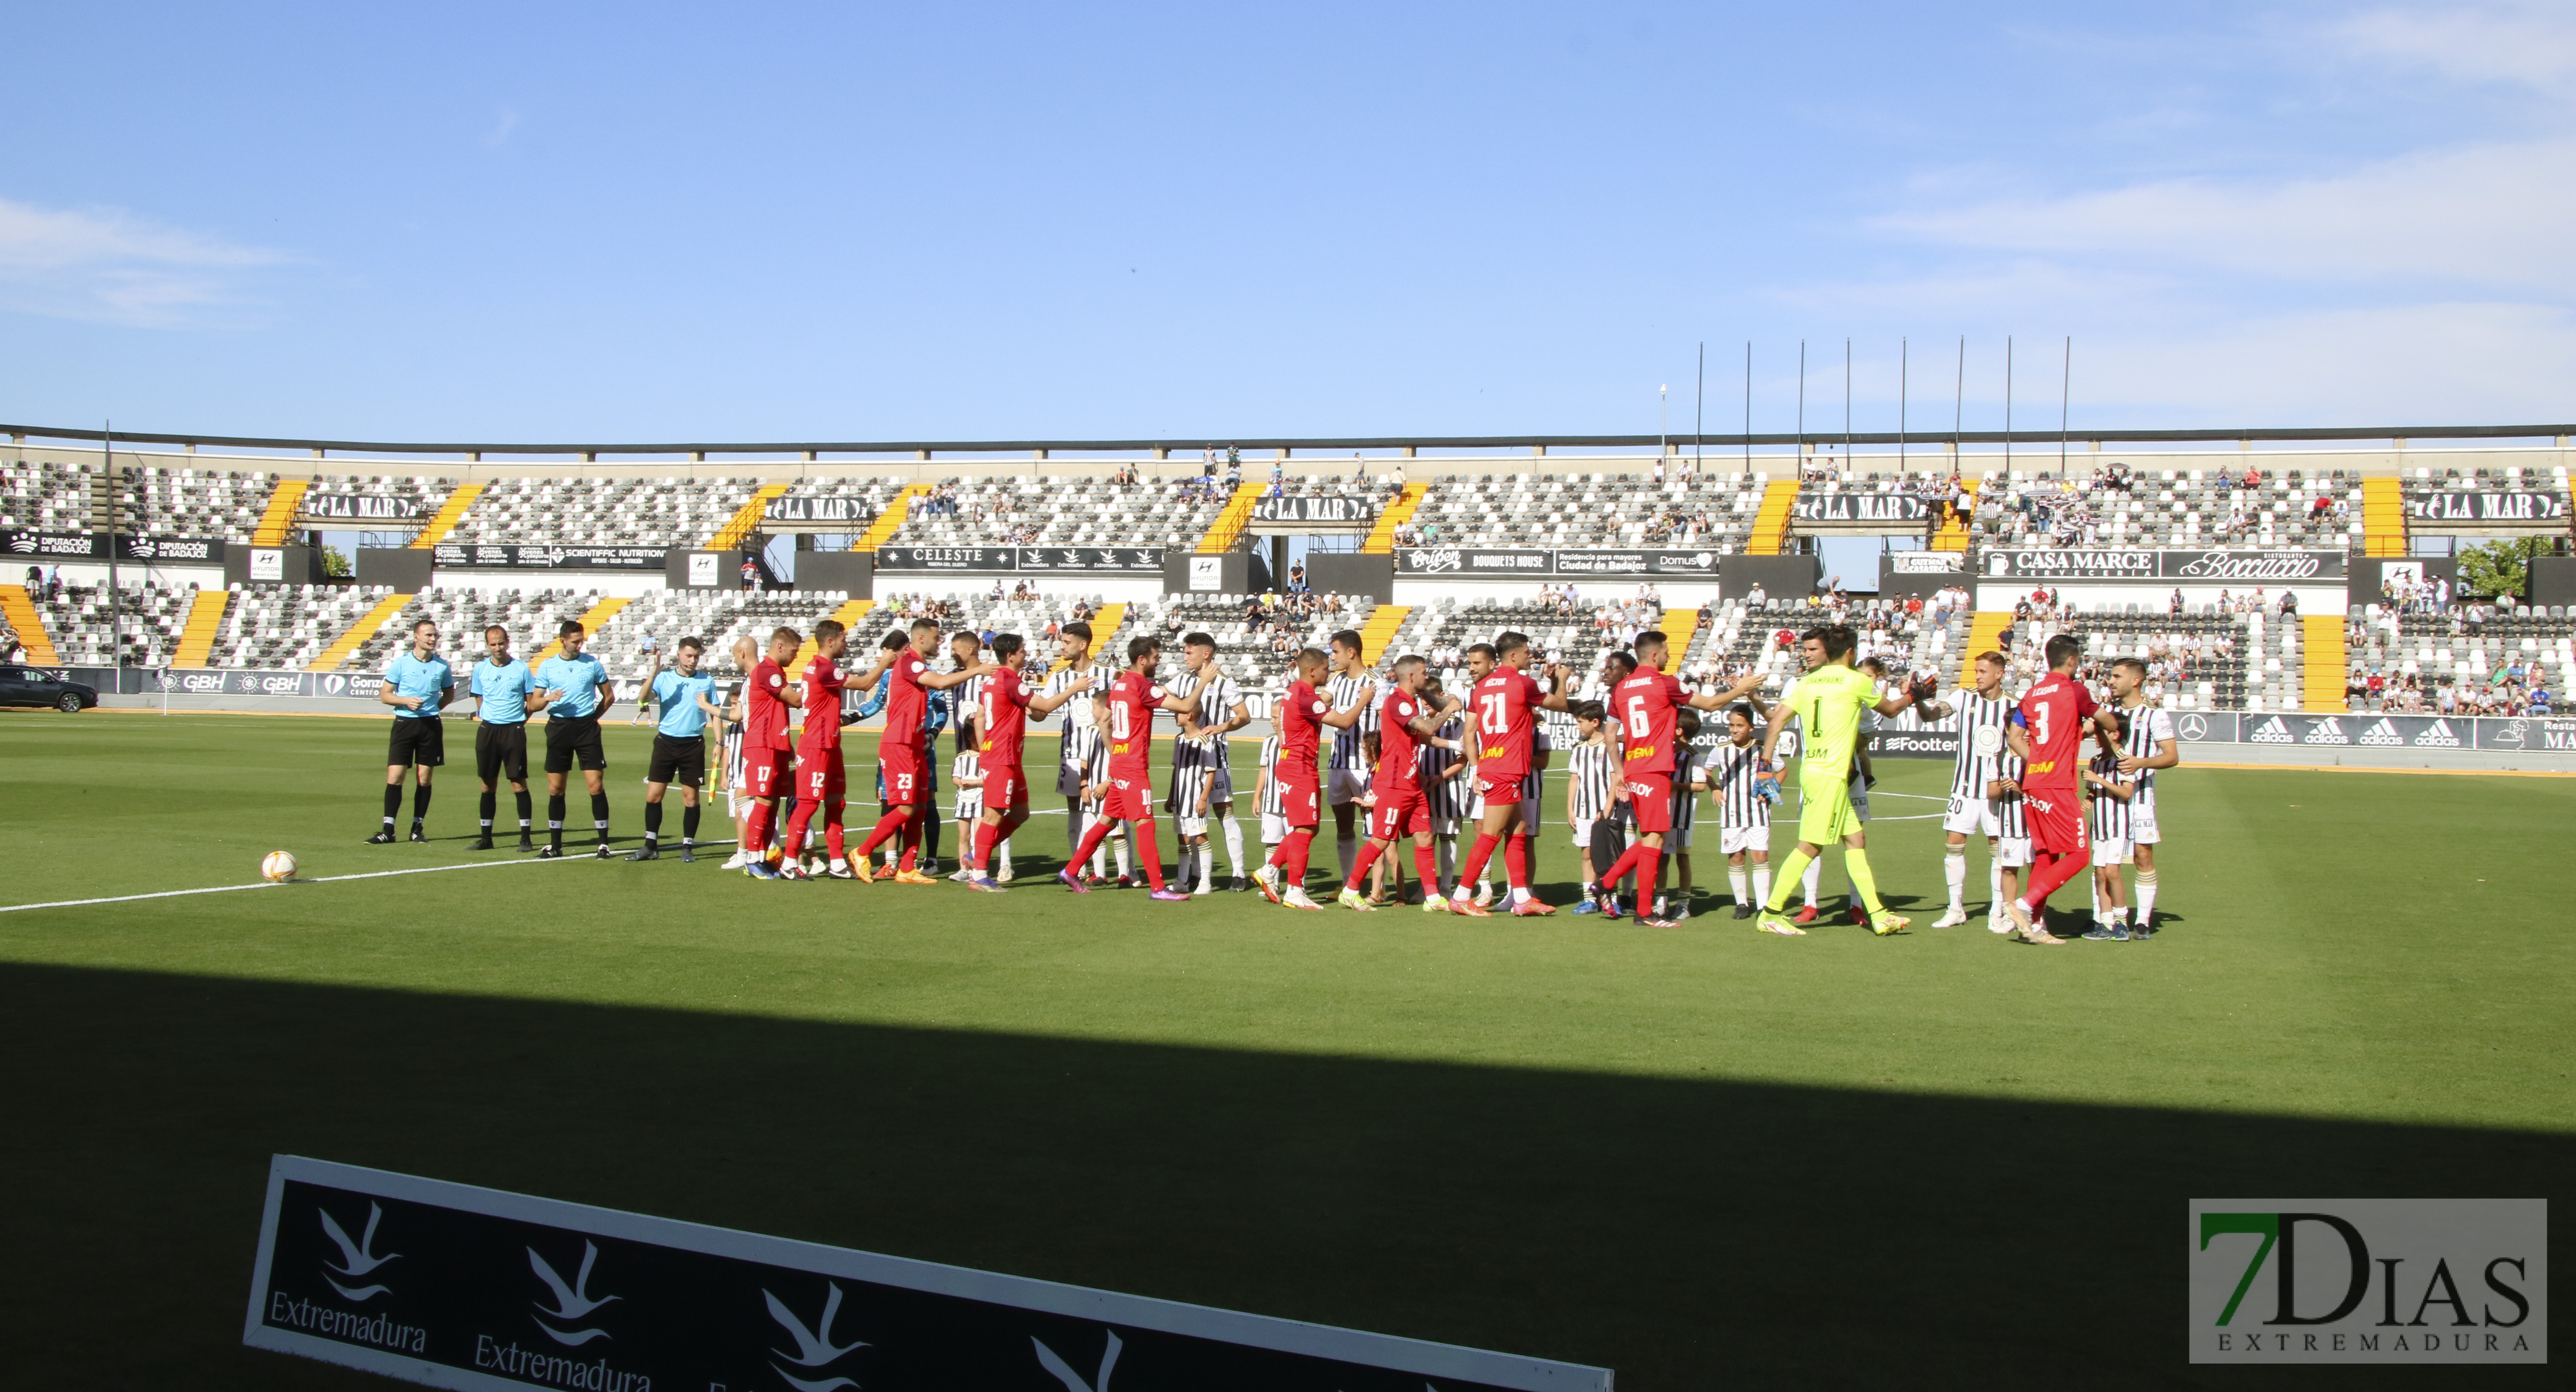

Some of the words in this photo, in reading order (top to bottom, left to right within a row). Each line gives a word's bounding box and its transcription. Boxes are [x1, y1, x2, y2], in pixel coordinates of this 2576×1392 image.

[329, 497, 352, 516] LA
[358, 497, 396, 517] MAR
[784, 499, 806, 519] LA
[811, 499, 848, 519] MAR
[1276, 498, 1299, 520] LA
[1306, 498, 1346, 520] MAR
[1823, 497, 1850, 519] LA
[1857, 497, 1902, 519] MAR
[2442, 494, 2473, 519] LA
[2481, 494, 2534, 519] MAR
[42, 537, 92, 546] DIPUTACIÓN
[52, 546, 91, 554] BADAJOZ
[159, 542, 208, 551] DIPUTACIÓN
[169, 550, 207, 558] BADAJOZ
[565, 549, 616, 557] SCIENTIFFIC
[619, 549, 664, 558] NUTRITION
[913, 549, 982, 561] CELESTE
[1473, 555, 1515, 567] BOUQUETS
[1517, 556, 1543, 567] HOUSE
[1660, 556, 1696, 565] Domus
[2017, 552, 2069, 569] CASA
[2072, 552, 2151, 569] MARCE
[1559, 561, 1593, 570] Ciudad
[1595, 561, 1605, 570] de
[1609, 561, 1647, 572] Badajoz
[2179, 552, 2320, 577] Boccaccio
[183, 672, 228, 692] GBH
[263, 673, 303, 694] GBH
[1110, 701, 1130, 739] 10
[1480, 692, 1508, 734] 21
[1628, 695, 1650, 738] 6
[1811, 696, 1823, 737] 1
[2035, 701, 2049, 745] 3
[2251, 732, 2294, 743] adidas
[2305, 733, 2348, 744] adidas
[2360, 734, 2403, 745] adidas
[2415, 735, 2459, 746] adidas
[758, 766, 771, 782] 17
[811, 772, 825, 788] 12
[897, 773, 913, 789] 23
[1006, 779, 1014, 795] 8
[1309, 792, 1317, 809] 4
[1947, 797, 1962, 815] 20
[1384, 807, 1398, 825] 11
[2077, 818, 2085, 836] 3
[270, 1291, 427, 1353] Extremadura
[475, 1334, 651, 1392] Extremadura
